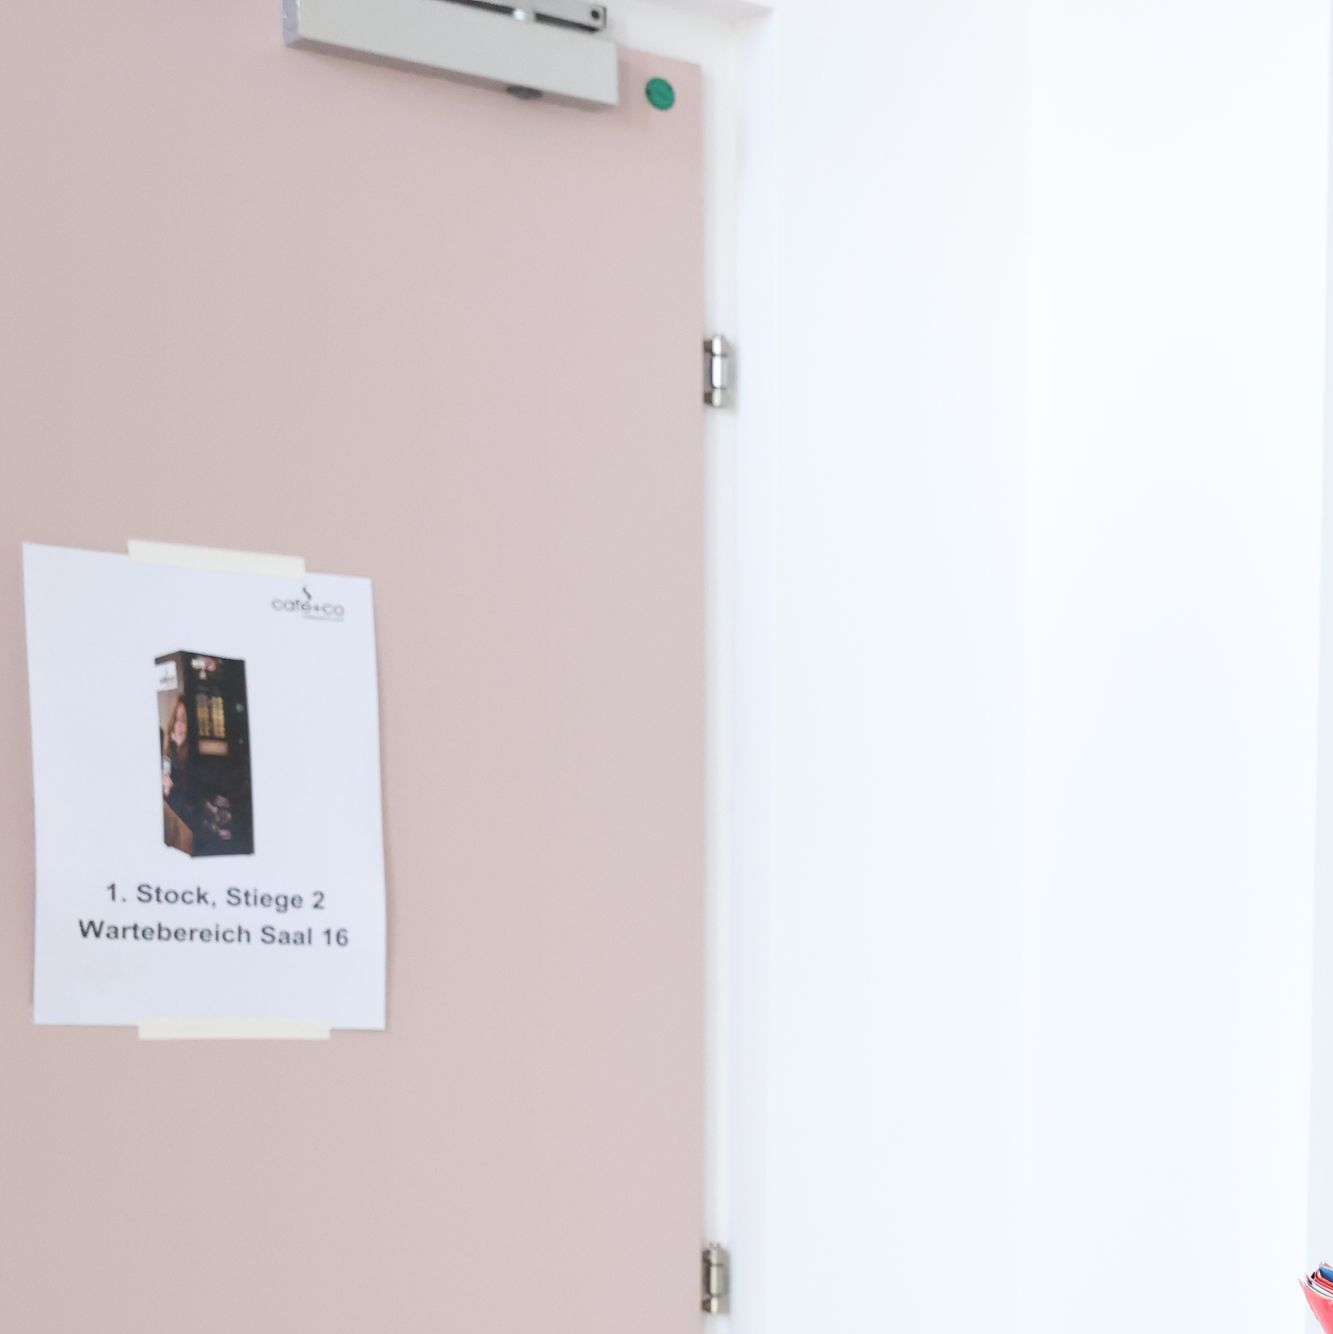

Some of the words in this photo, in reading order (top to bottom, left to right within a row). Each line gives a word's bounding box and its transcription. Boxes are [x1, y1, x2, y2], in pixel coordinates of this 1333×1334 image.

[106, 883, 127, 902] 1.
[136, 883, 217, 909] Stock,
[226, 887, 304, 913] Stiege
[312, 890, 326, 910] 2
[78, 918, 252, 943] Wartebereich
[261, 925, 313, 945] Saal
[322, 928, 349, 947] 16
